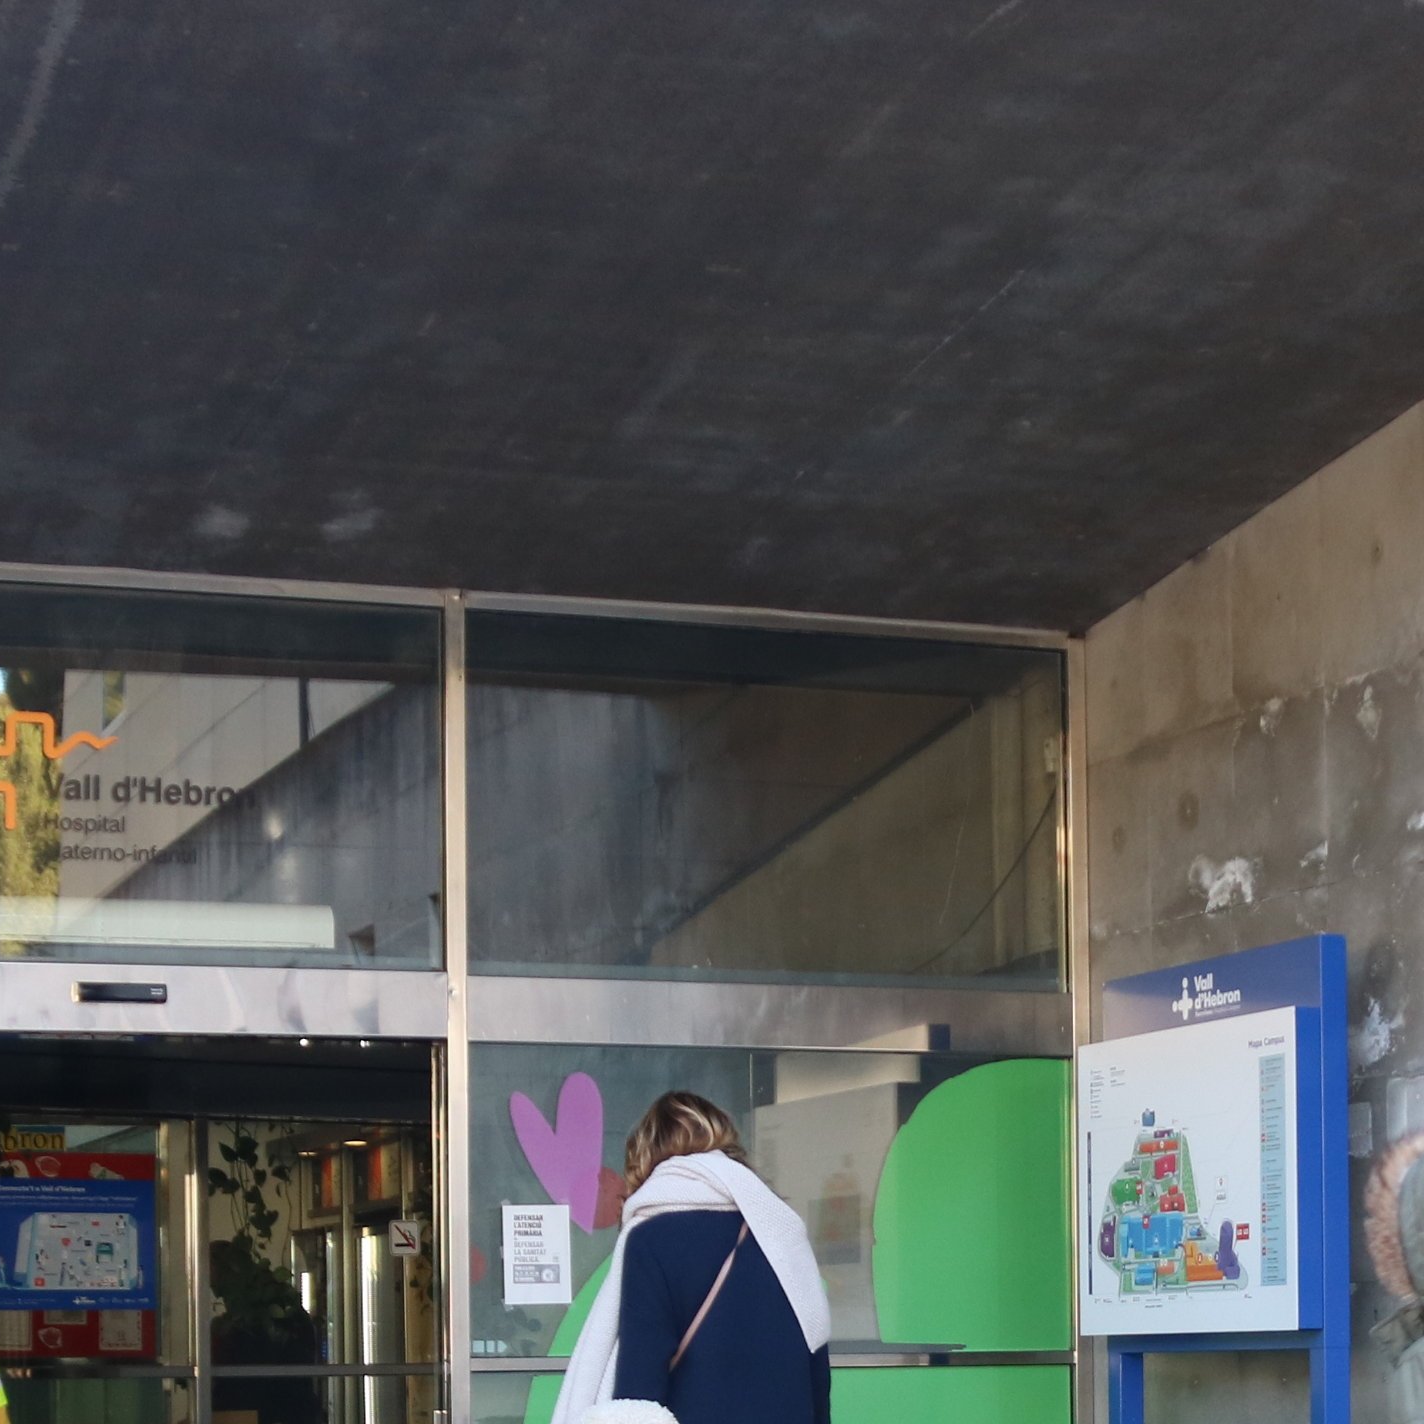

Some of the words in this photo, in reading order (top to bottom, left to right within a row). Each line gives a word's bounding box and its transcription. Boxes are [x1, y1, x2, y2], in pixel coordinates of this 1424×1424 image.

[42, 772, 100, 801] Vall
[111, 775, 257, 809] d'Hebron
[43, 812, 125, 834] Hospital
[1194, 972, 1214, 992] Vall
